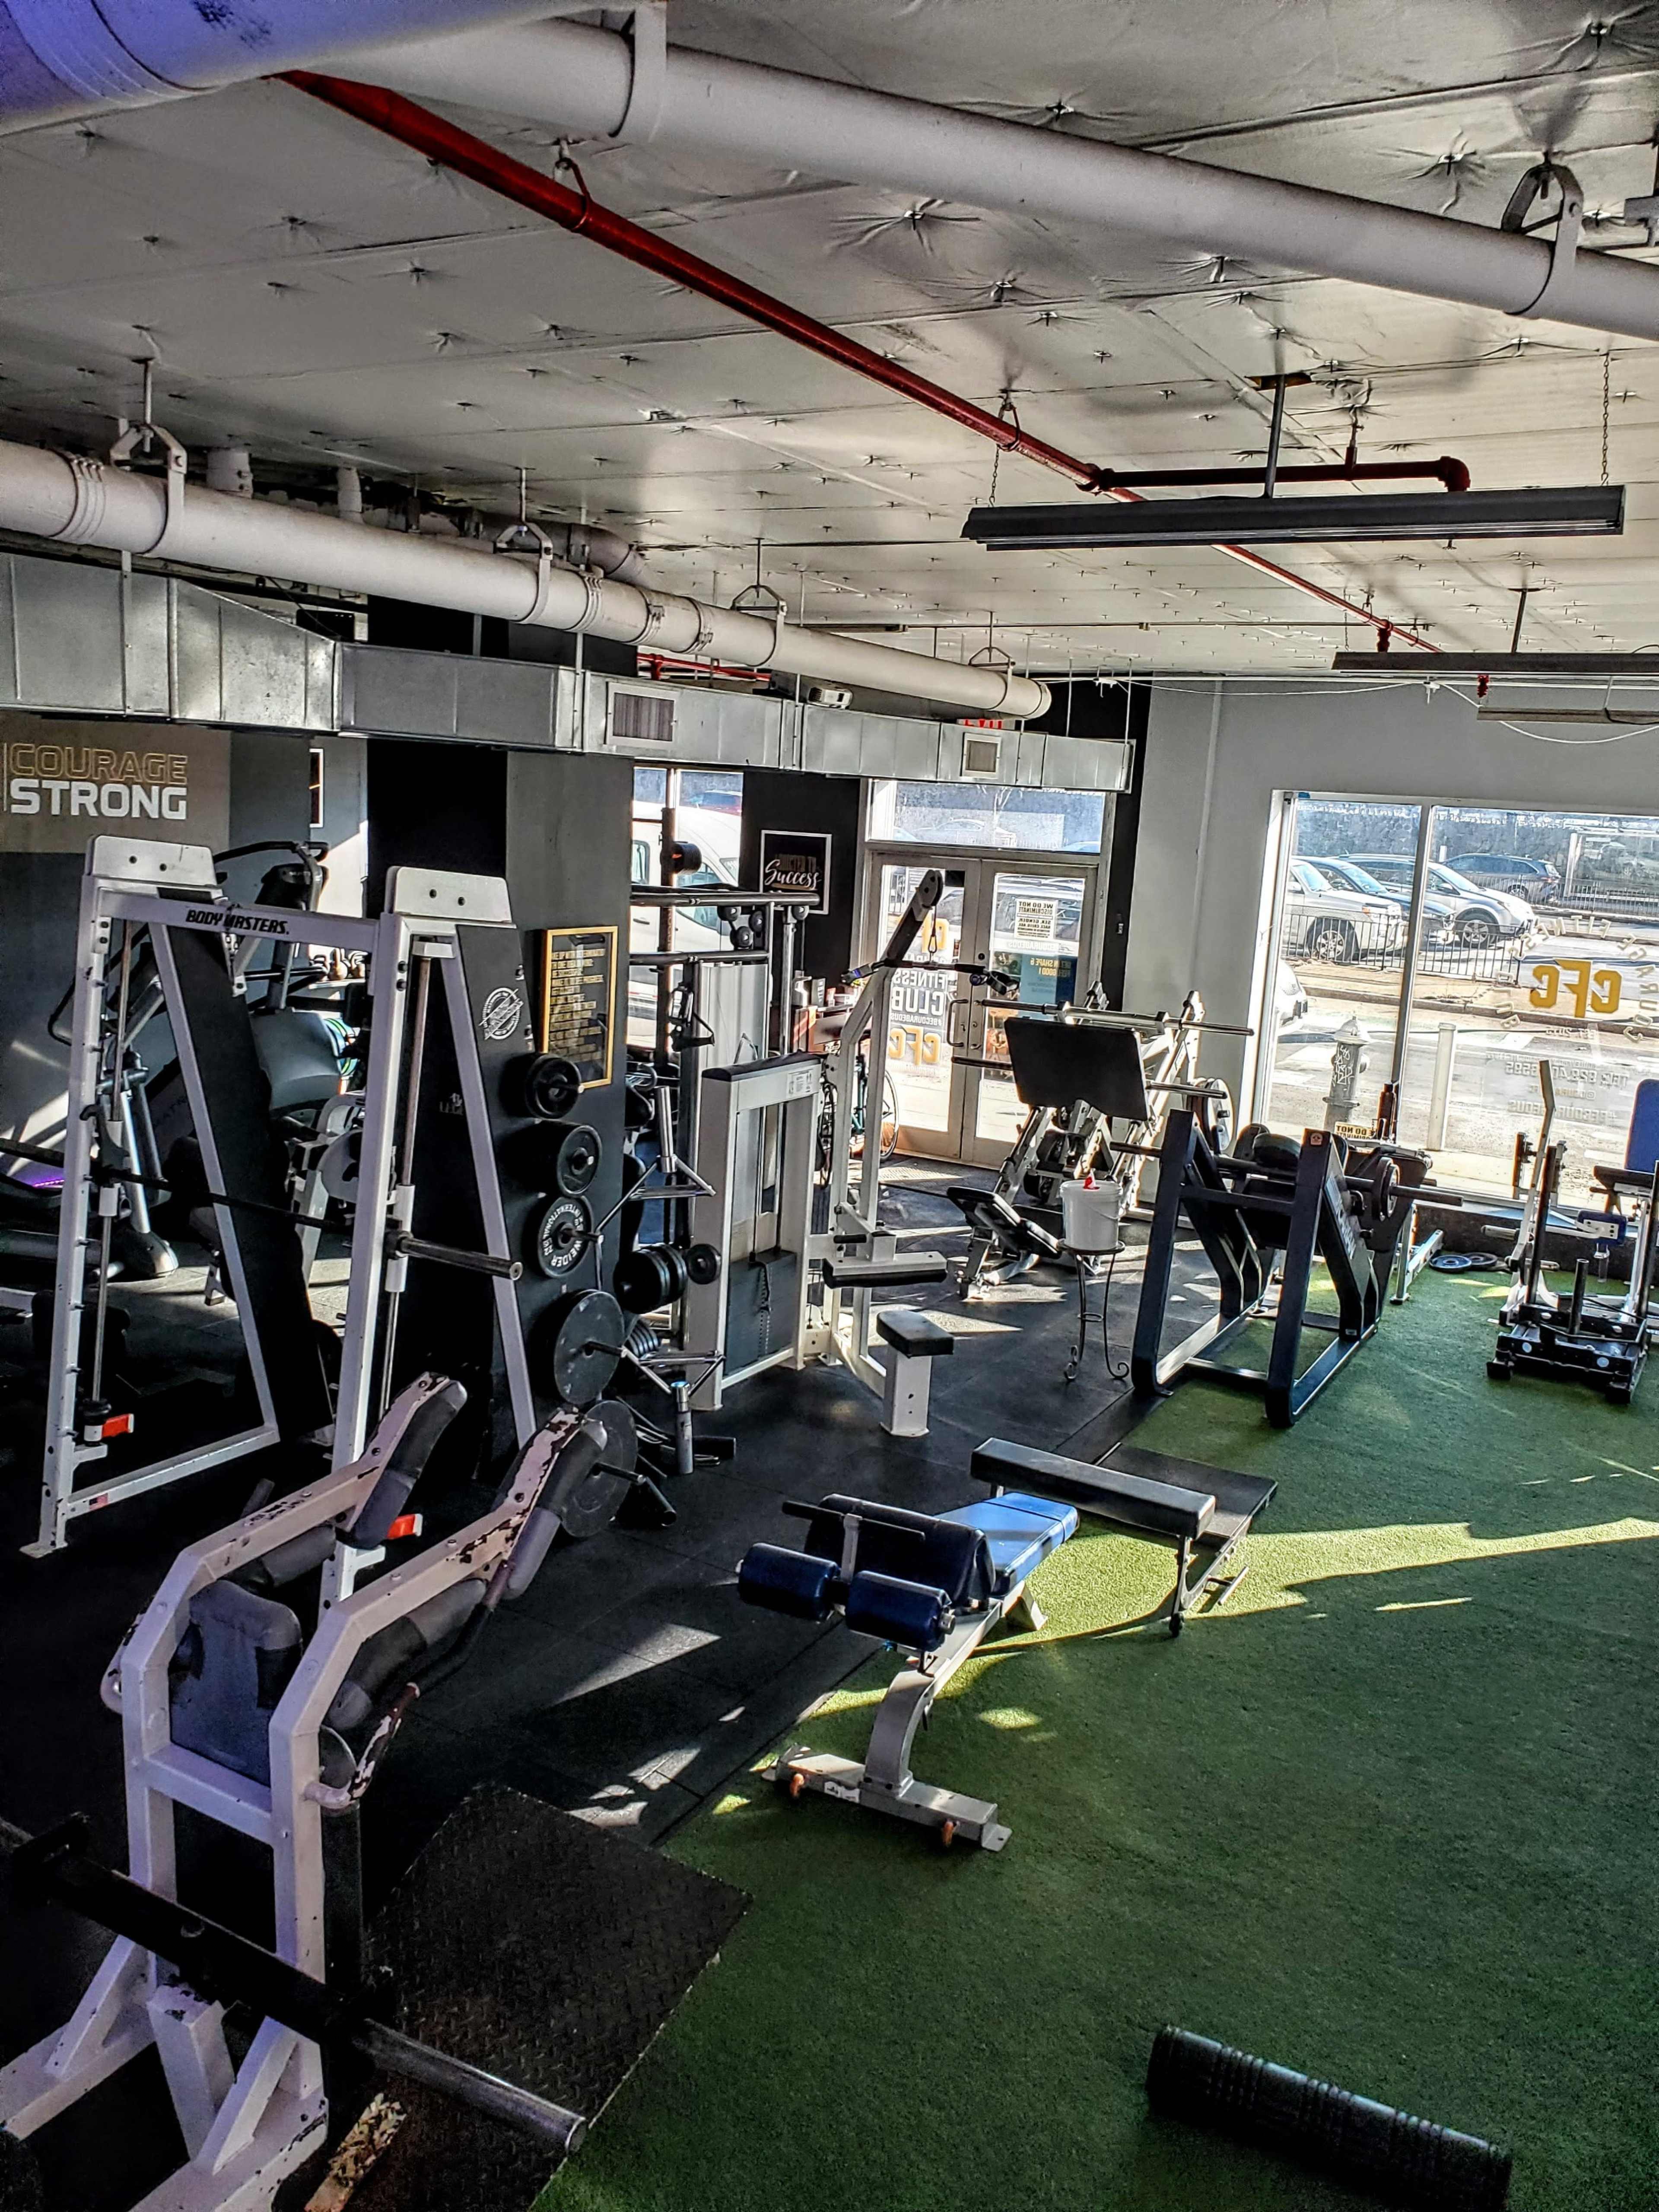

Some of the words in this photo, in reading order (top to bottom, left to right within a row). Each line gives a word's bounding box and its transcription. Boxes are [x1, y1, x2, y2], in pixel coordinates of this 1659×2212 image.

[10, 744, 188, 785] COURAGE
[10, 778, 188, 820] STRONG
[764, 859, 822, 890] Success
[185, 909, 223, 926] BODY
[551, 1240, 582, 1267] WEIDER
